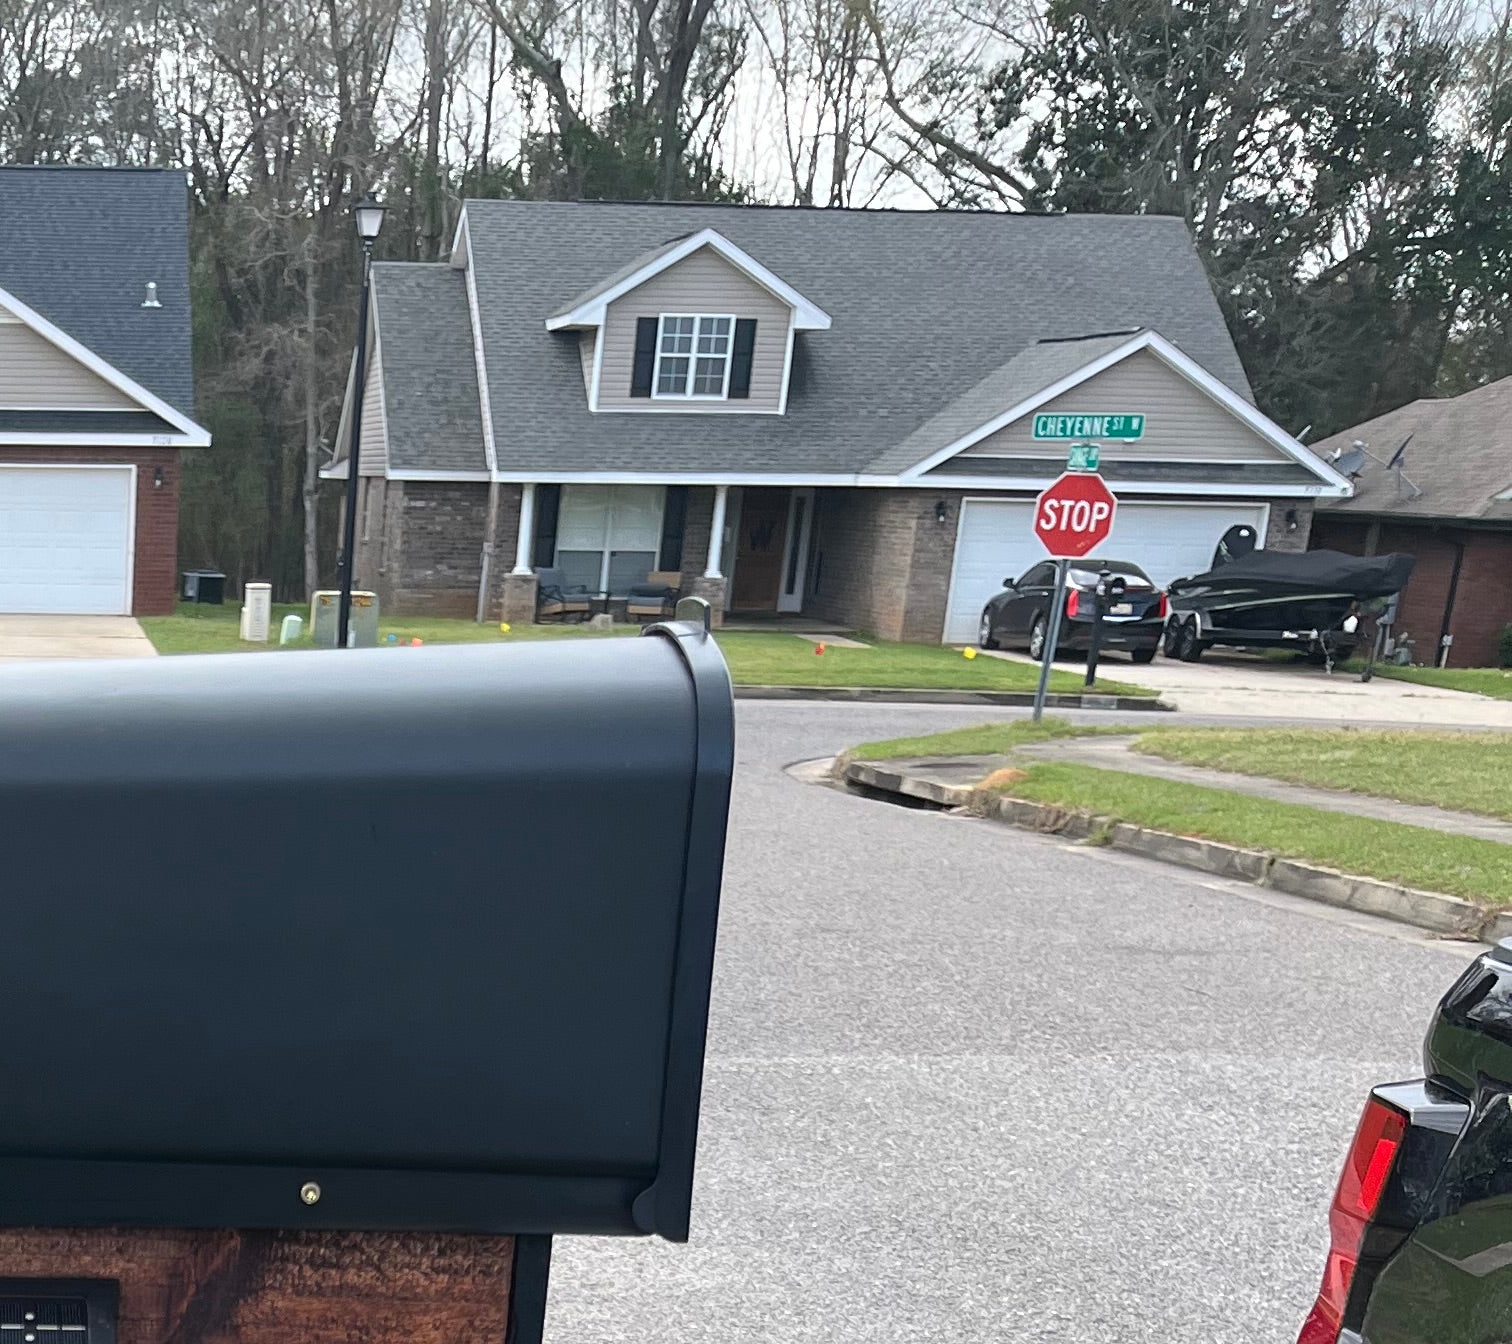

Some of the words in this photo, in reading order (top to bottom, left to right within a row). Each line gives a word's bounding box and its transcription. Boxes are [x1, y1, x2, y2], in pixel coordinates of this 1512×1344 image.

[1037, 416, 1110, 436] CHEYENNE
[1112, 416, 1125, 431] ST
[1039, 498, 1110, 533] STOP
